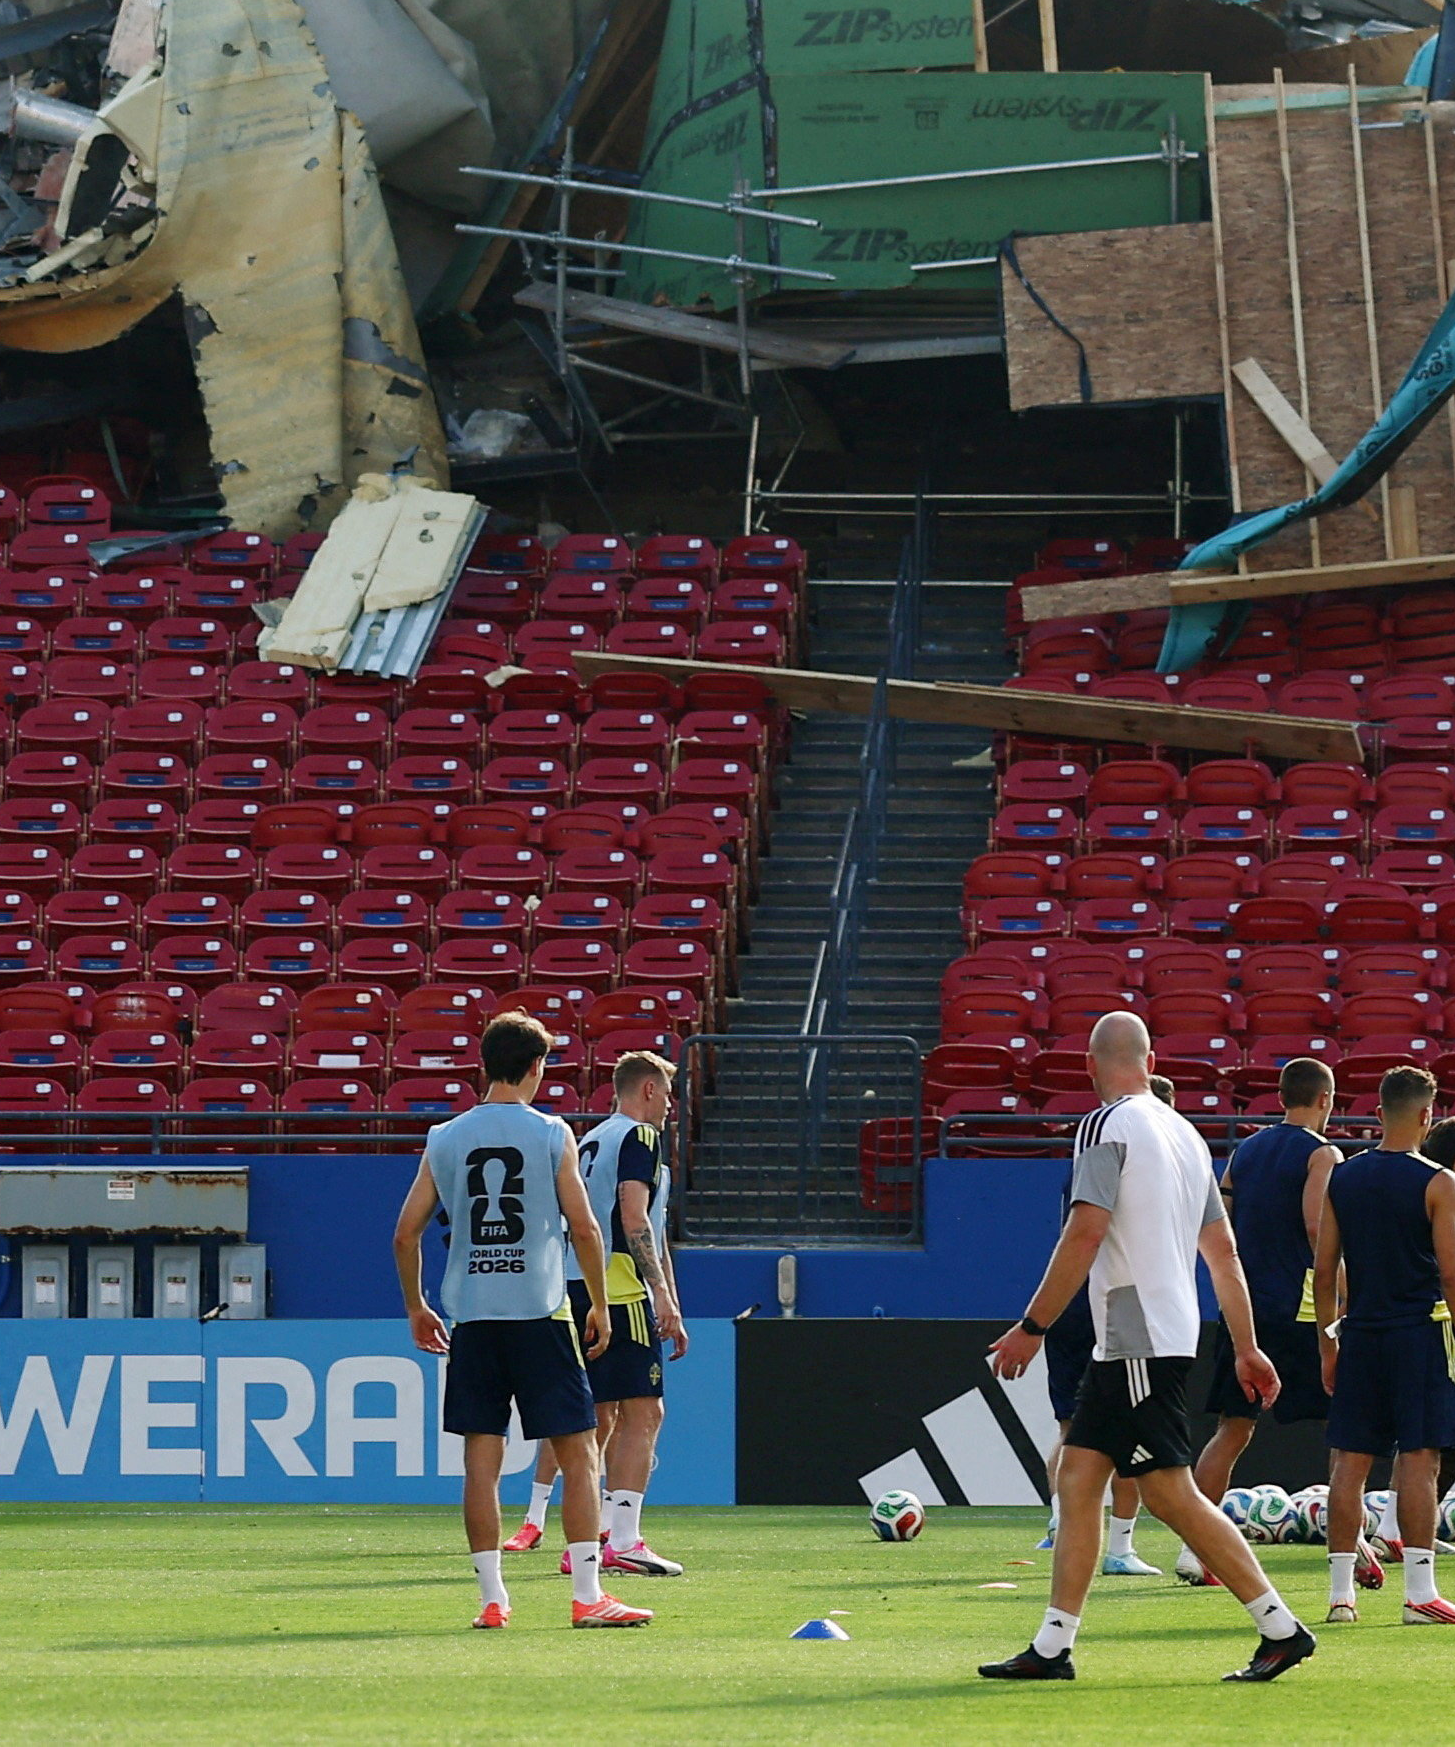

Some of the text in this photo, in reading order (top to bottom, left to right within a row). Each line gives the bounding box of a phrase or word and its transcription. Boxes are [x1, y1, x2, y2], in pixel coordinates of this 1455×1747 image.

[972, 95, 1168, 133] ZIPsystem
[480, 1225, 509, 1237] FIFA
[503, 1248, 525, 1258] CUP
[467, 1259, 525, 1275] 2026
